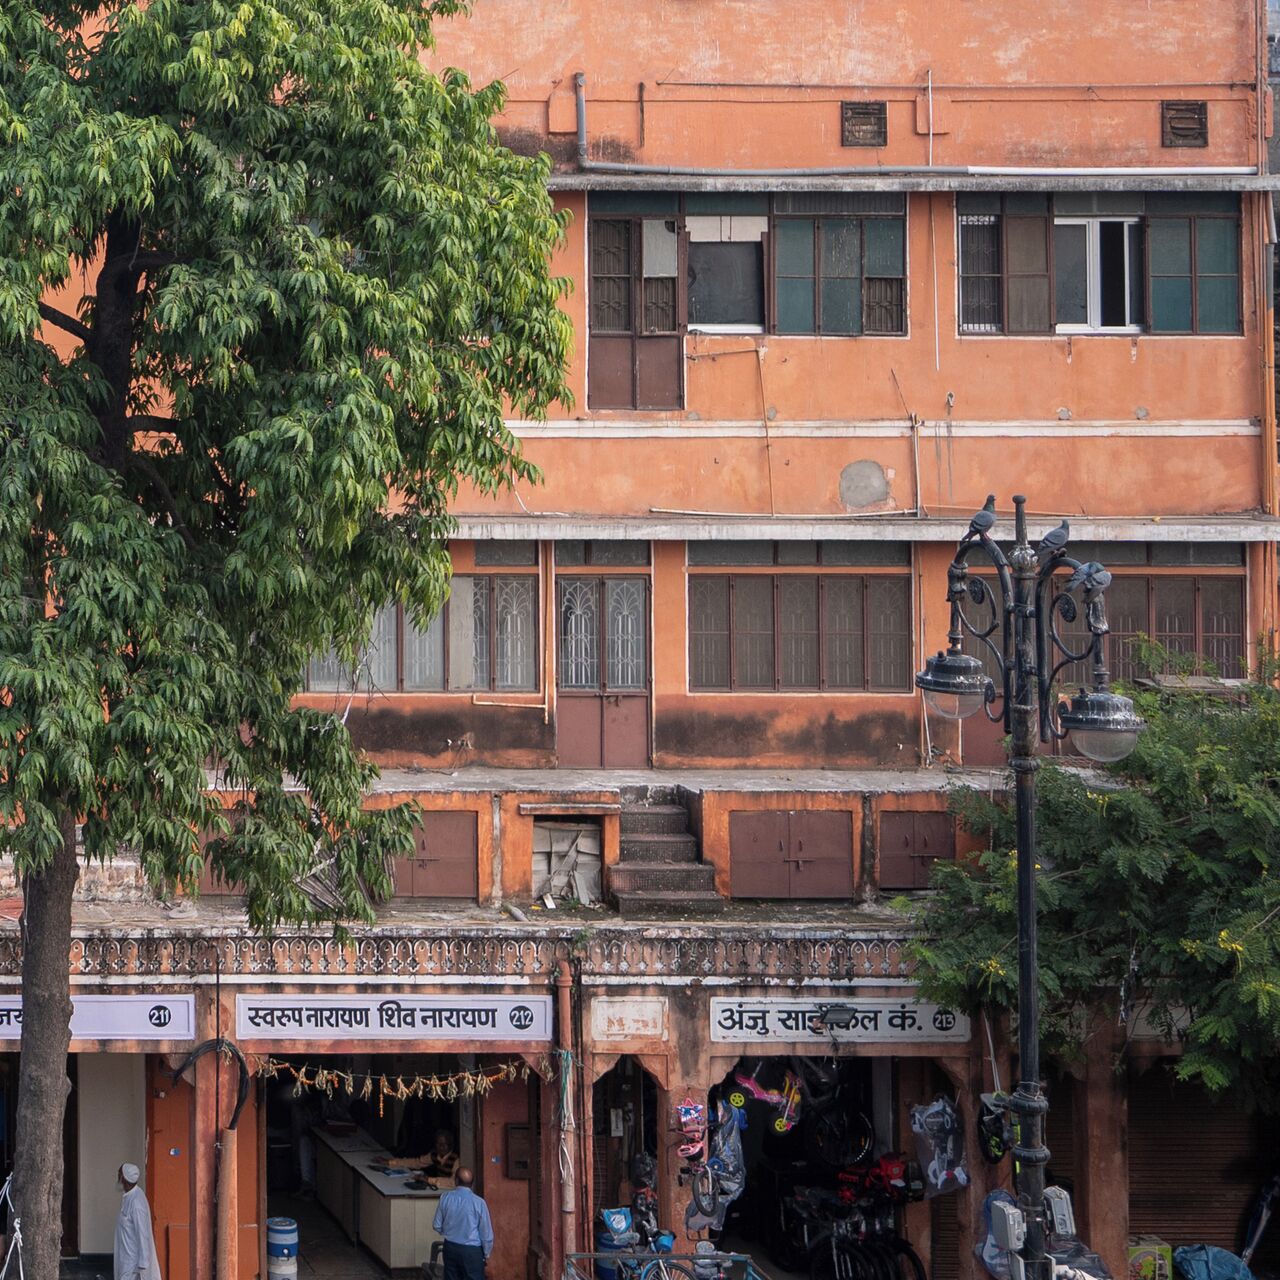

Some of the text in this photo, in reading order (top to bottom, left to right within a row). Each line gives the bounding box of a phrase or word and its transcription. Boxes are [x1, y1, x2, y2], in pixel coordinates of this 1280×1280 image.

[148, 1007, 171, 1025] 211
[305, 1007, 371, 1028] नारायण
[377, 1000, 417, 1028] शिव
[420, 1007, 498, 1028] नारायण
[509, 1009, 534, 1025] 212
[717, 1003, 770, 1035] अंजु
[888, 1003, 923, 1032] कं.
[934, 1012, 955, 1028] 213
